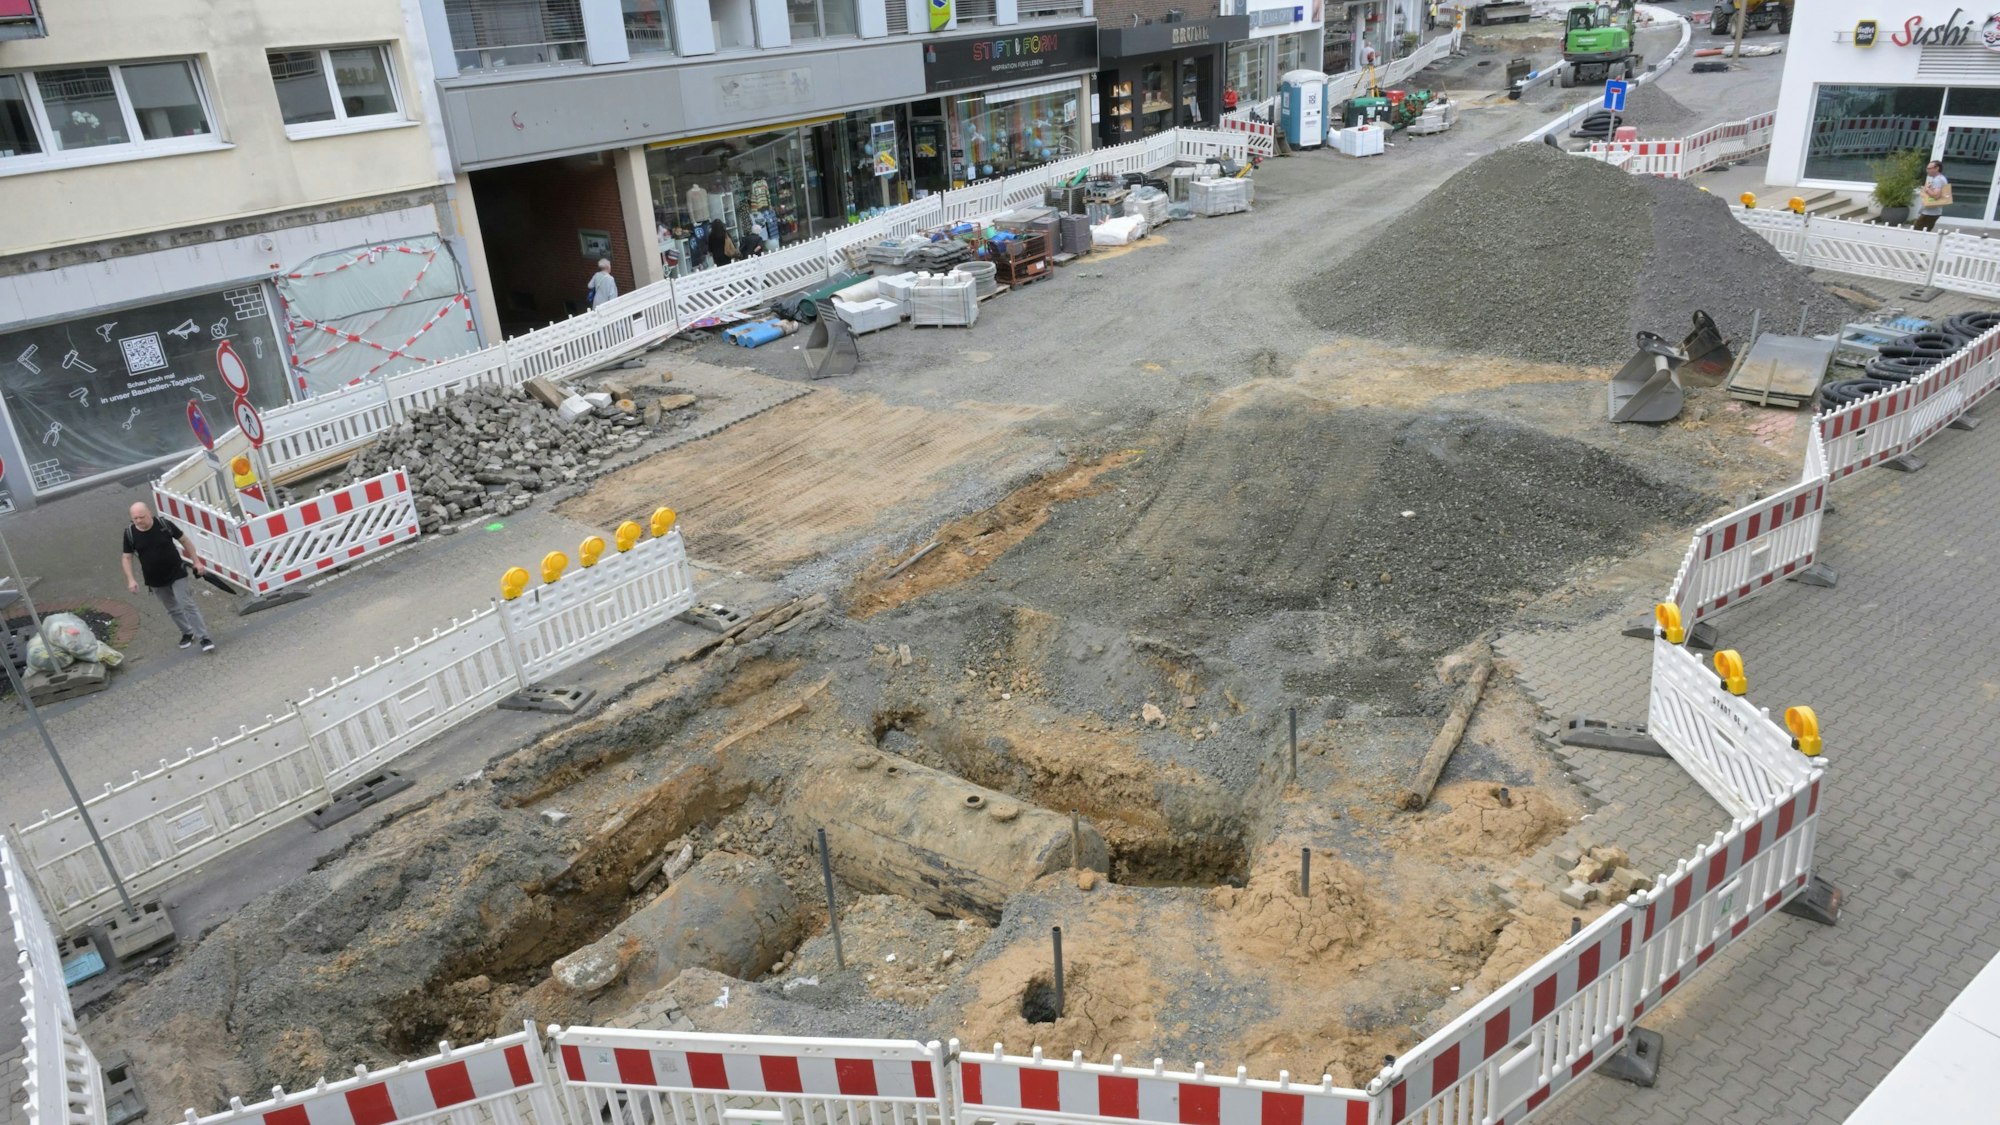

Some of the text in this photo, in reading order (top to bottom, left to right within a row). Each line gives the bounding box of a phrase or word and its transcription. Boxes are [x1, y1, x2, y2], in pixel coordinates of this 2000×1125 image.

[1891, 7, 1974, 47] Sushi
[973, 34, 1057, 61] STIFT FORM
[109, 392, 130, 402] unser
[131, 374, 205, 397] Baustellen-Tagebuch
[127, 380, 147, 389] Schau
[148, 376, 163, 384] doch
